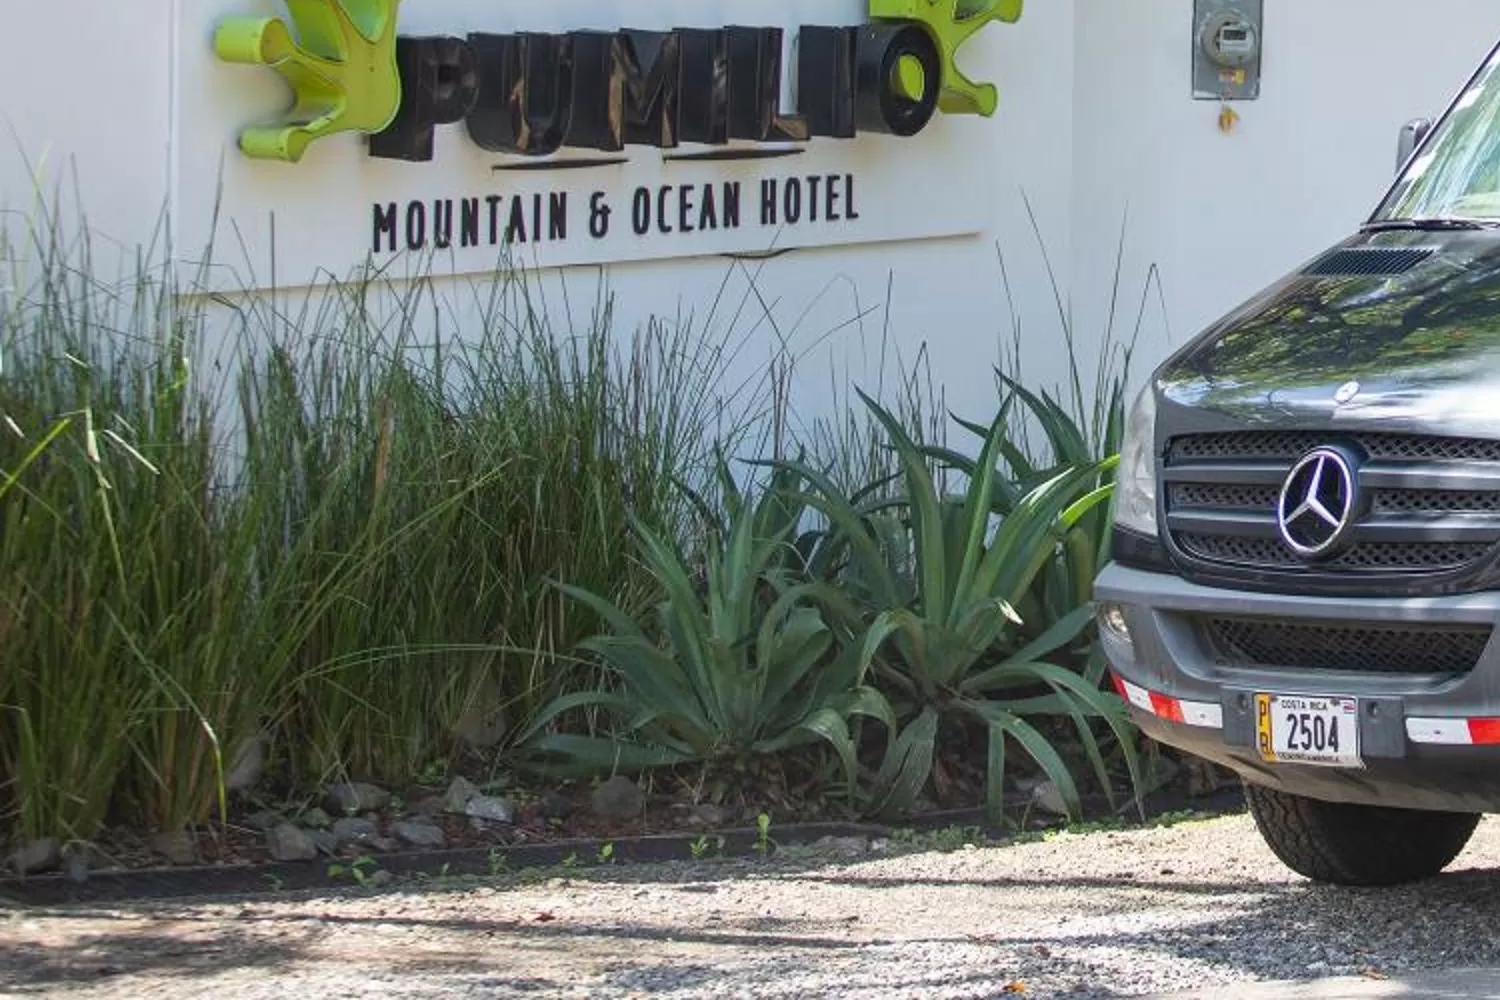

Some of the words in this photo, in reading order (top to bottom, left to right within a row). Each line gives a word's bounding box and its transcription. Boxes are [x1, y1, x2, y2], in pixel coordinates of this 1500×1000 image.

[368, 20, 942, 162] PUMILIO
[373, 191, 567, 253] MOUNTAIN
[589, 191, 612, 239] &
[631, 180, 741, 235] OCEAN
[760, 173, 860, 225] HOTEL
[1281, 699, 1306, 710] COSTA
[1309, 701, 1328, 711] RICA
[1287, 713, 1339, 753] 2504
